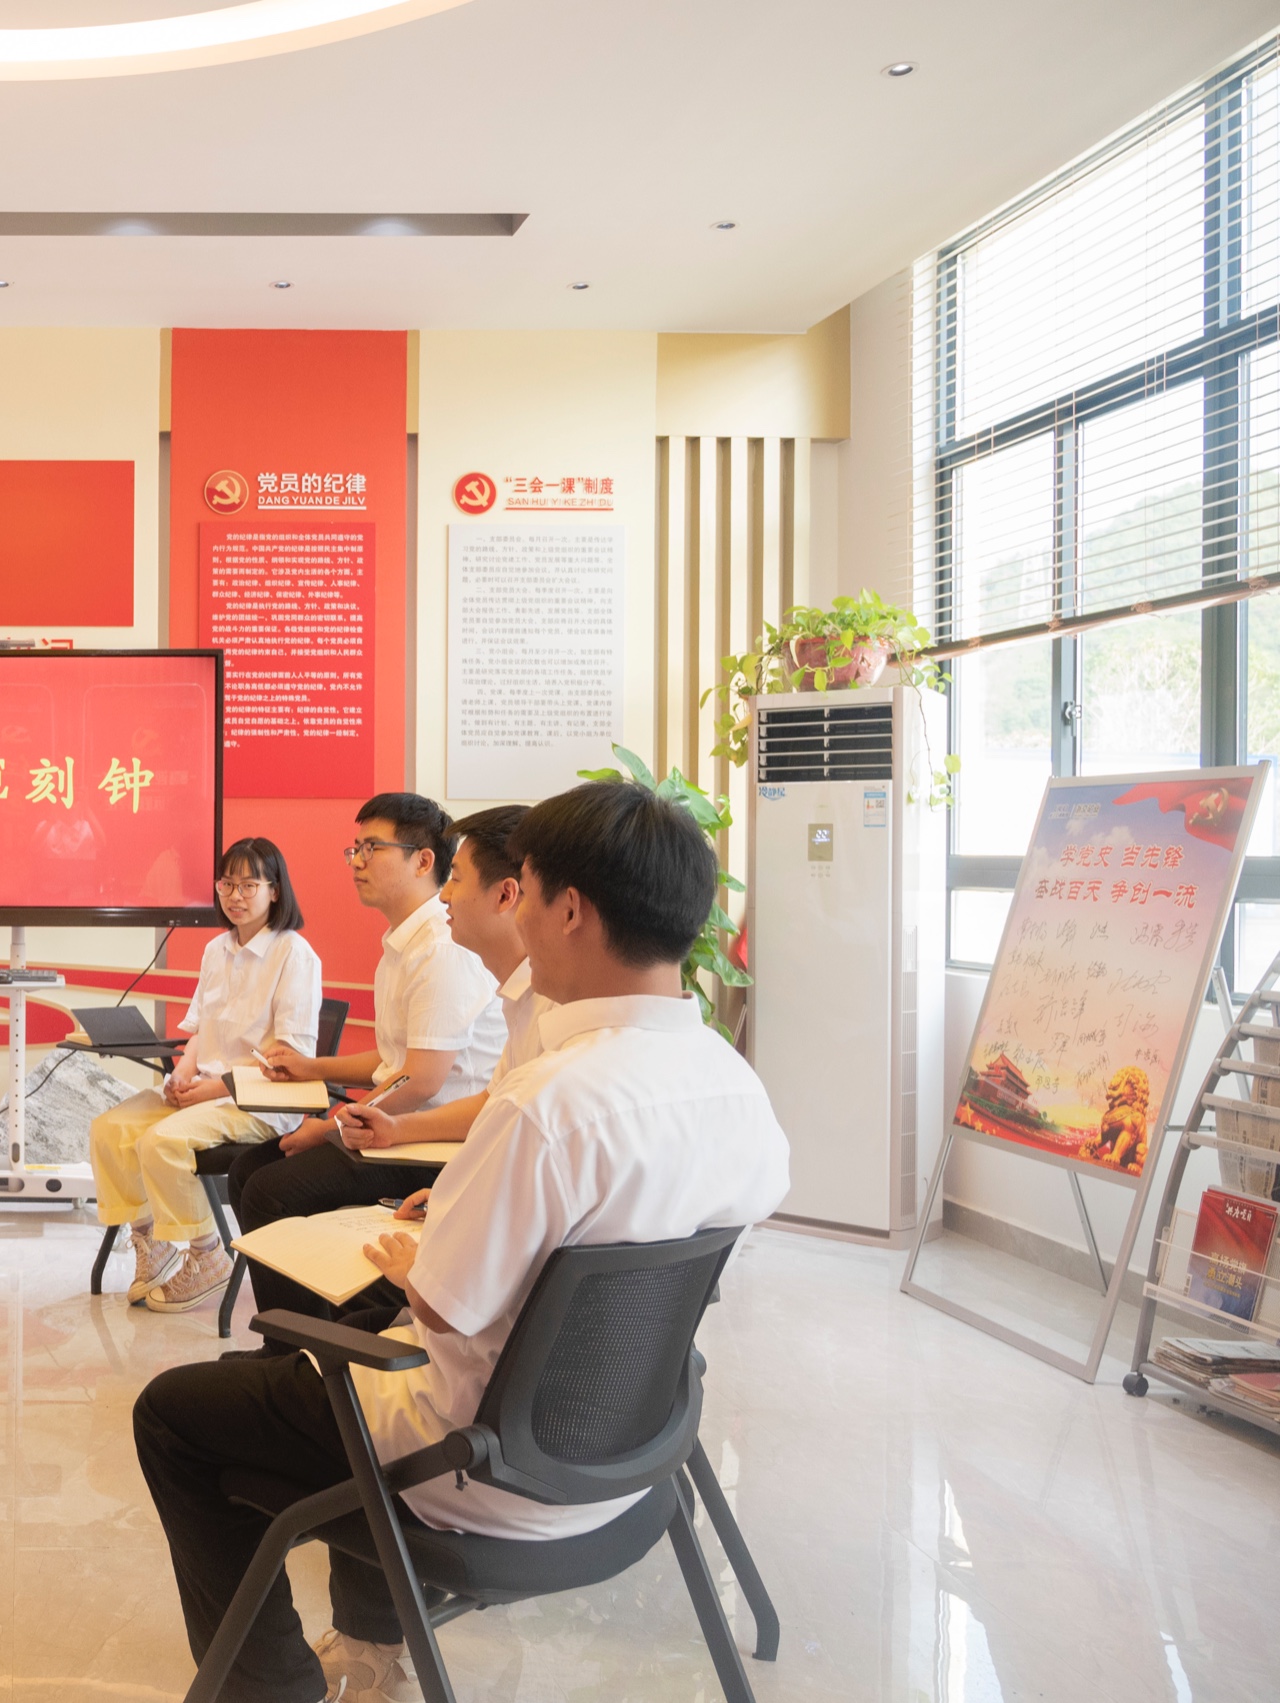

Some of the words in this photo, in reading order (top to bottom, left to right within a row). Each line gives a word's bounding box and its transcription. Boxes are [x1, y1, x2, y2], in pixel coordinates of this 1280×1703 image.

[258, 472, 366, 494] 党员的纪律
[258, 496, 289, 505] DANG
[292, 496, 322, 505] YUAN
[325, 496, 339, 505] DE
[342, 496, 365, 505] JILV
[1060, 844, 1113, 868] 学党史
[1121, 843, 1184, 869] 当先锋
[1035, 879, 1103, 902] 奋战百天
[1111, 880, 1198, 909] 争创一流
